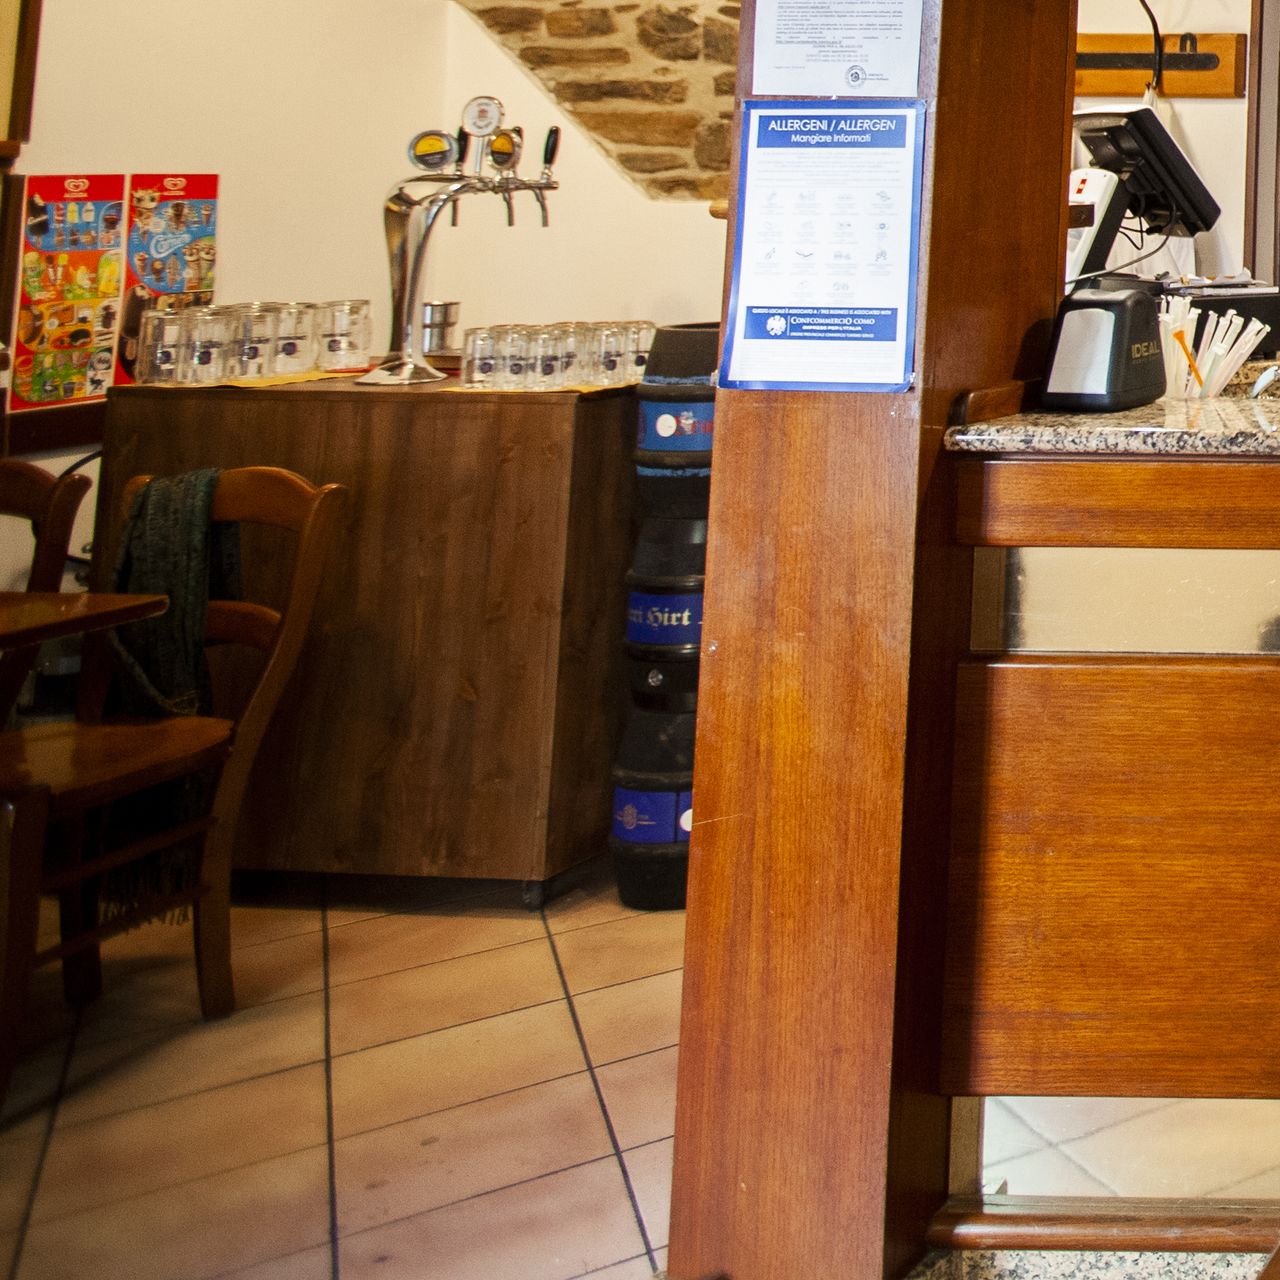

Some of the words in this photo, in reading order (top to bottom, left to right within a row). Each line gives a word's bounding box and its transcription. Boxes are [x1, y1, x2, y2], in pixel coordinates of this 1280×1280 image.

[768, 119, 828, 131] ALLERGENI
[830, 119, 836, 131] /
[837, 119, 896, 131] ALLERGEN
[791, 133, 832, 144] Mangiare
[833, 133, 871, 143] Informati
[1131, 341, 1160, 359] IDEAL
